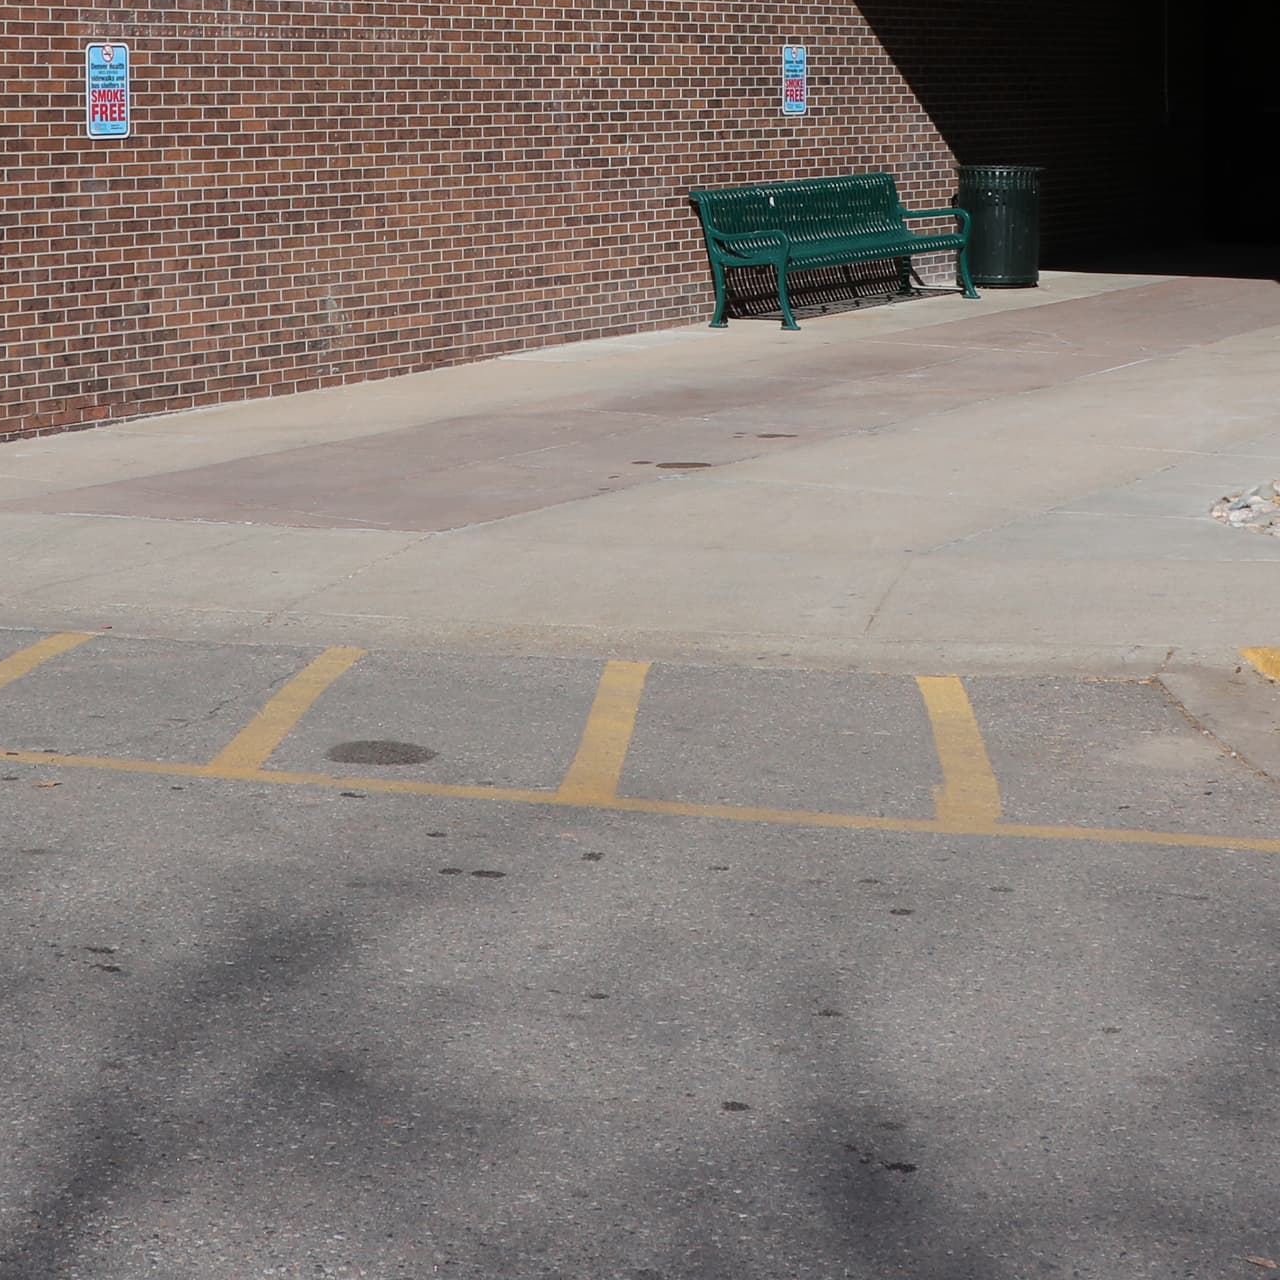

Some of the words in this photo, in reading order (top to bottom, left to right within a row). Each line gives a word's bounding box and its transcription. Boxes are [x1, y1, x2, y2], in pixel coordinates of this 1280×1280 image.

[91, 89, 125, 103] SMOKE
[785, 89, 805, 102] FREE
[91, 103, 126, 122] FREE
